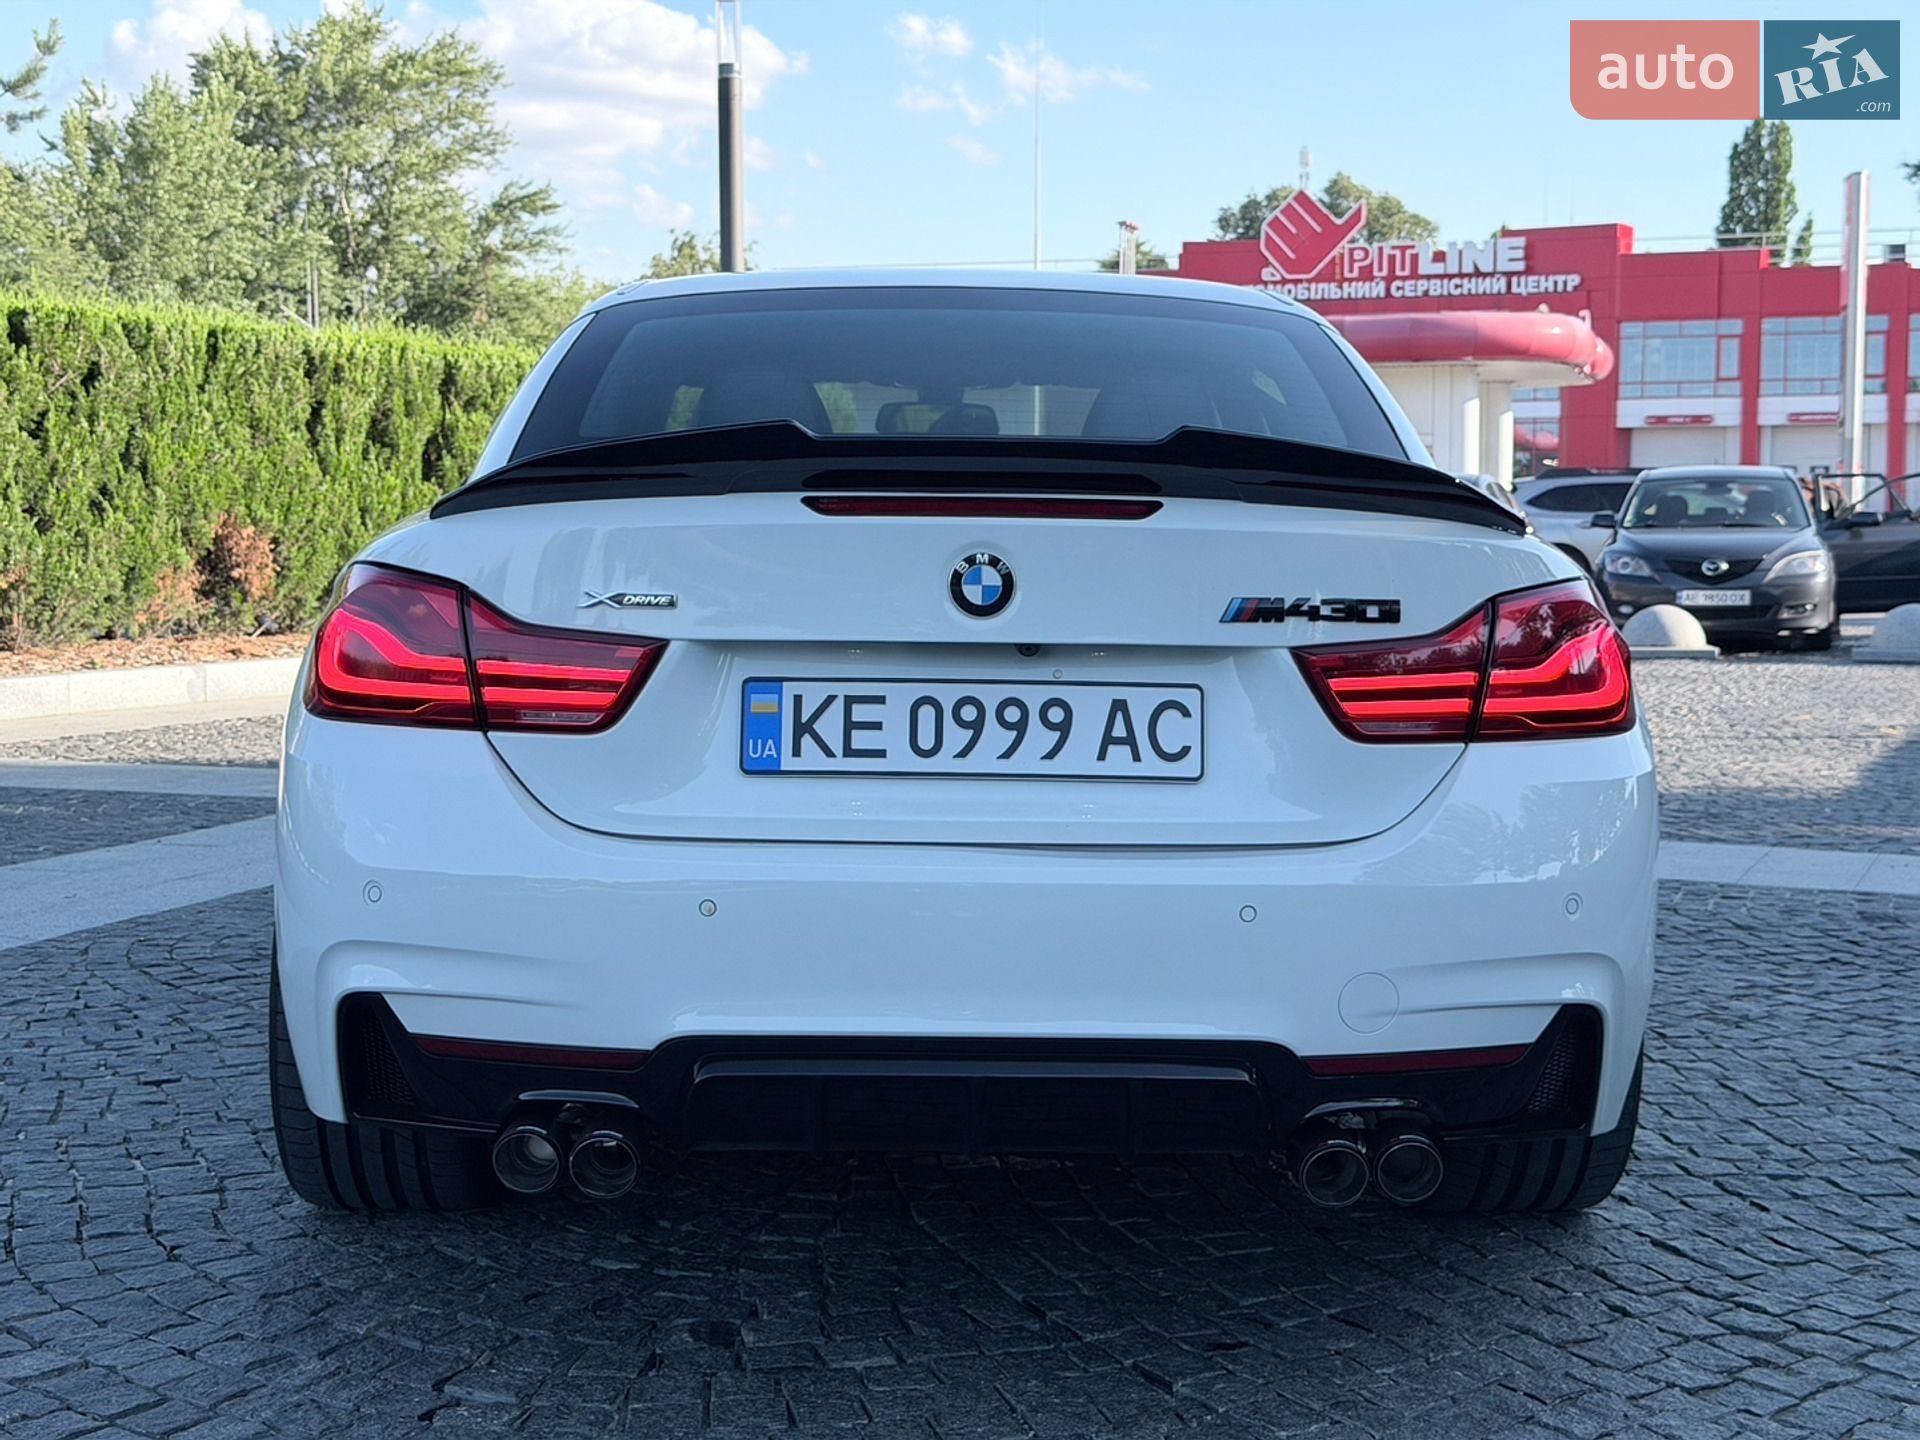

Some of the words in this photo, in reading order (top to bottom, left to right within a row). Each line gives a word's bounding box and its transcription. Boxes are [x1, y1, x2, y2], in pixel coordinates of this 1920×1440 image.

[1342, 236, 1527, 279] PITLINE
[1389, 275, 1508, 298] СЕРВІСНИЙ
[1510, 273, 1582, 296] ЦЕНТР
[955, 553, 1010, 575] BMW
[791, 693, 888, 759] KE
[909, 694, 1074, 760] 0999
[1096, 698, 1193, 763] AC
[748, 738, 778, 758] UA
